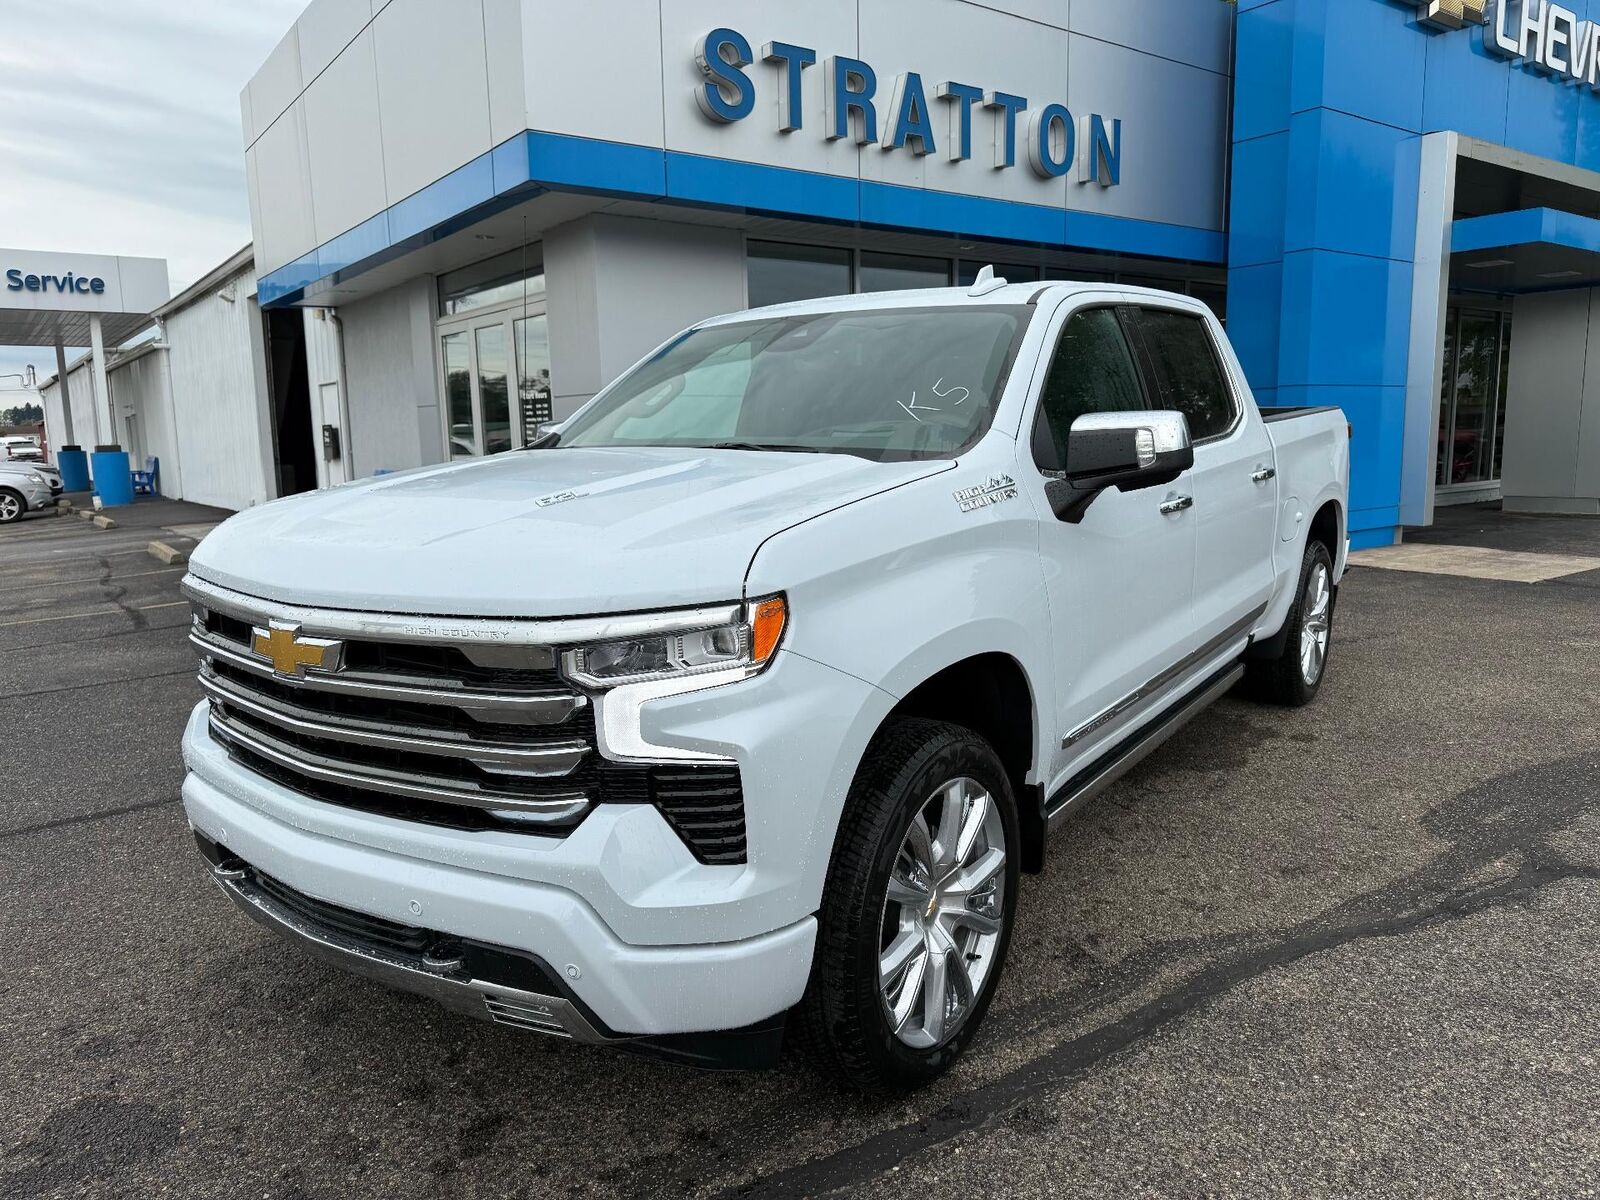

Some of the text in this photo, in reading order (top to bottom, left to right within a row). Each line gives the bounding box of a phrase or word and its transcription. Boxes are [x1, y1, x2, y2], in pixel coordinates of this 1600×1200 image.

[695, 27, 1121, 187] STRATTON
[6, 269, 105, 294] Service
[404, 626, 509, 639] HIGH COUNTRY
